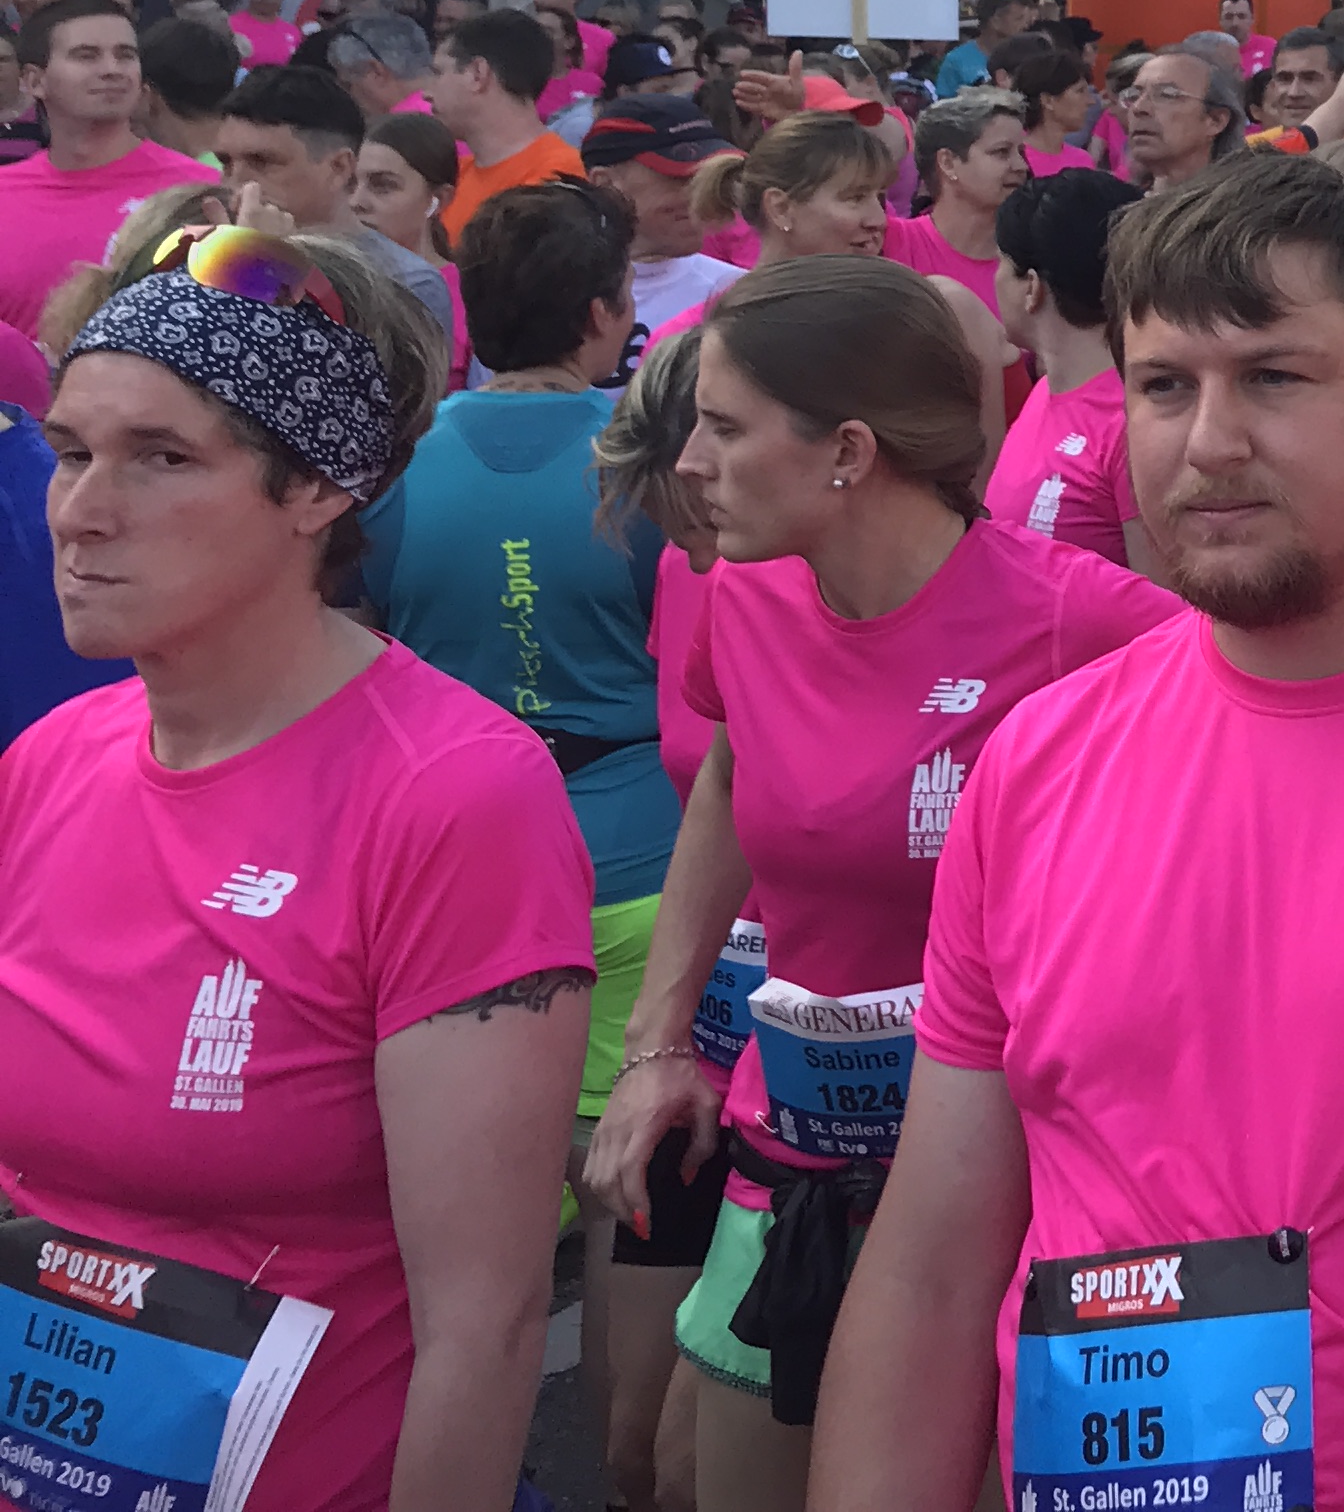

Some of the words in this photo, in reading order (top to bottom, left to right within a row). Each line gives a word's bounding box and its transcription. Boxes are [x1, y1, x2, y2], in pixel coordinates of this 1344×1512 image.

[911, 746, 966, 794] AUF
[908, 808, 955, 833] LAU
[191, 956, 263, 1020] AUF
[186, 1017, 255, 1042] FAHRTS
[178, 1038, 252, 1076] LAUF
[803, 1045, 900, 1071] Sabine
[817, 1081, 906, 1114] 1824
[831, 1120, 886, 1138] Gallen
[37, 1240, 157, 1310] SPORTXX
[1070, 1255, 1185, 1306] SPORTXX
[1107, 1298, 1144, 1314] MIGROS
[24, 1312, 117, 1376] Lilian
[1079, 1344, 1170, 1386] Timo
[6, 1371, 105, 1448] 1523
[1081, 1405, 1166, 1466] 815
[56, 1461, 112, 1498] 2019
[1053, 1486, 1076, 1512] St.
[1080, 1479, 1146, 1512] Gallen
[1152, 1474, 1210, 1507] 2019
[1244, 1458, 1284, 1496] AUF
